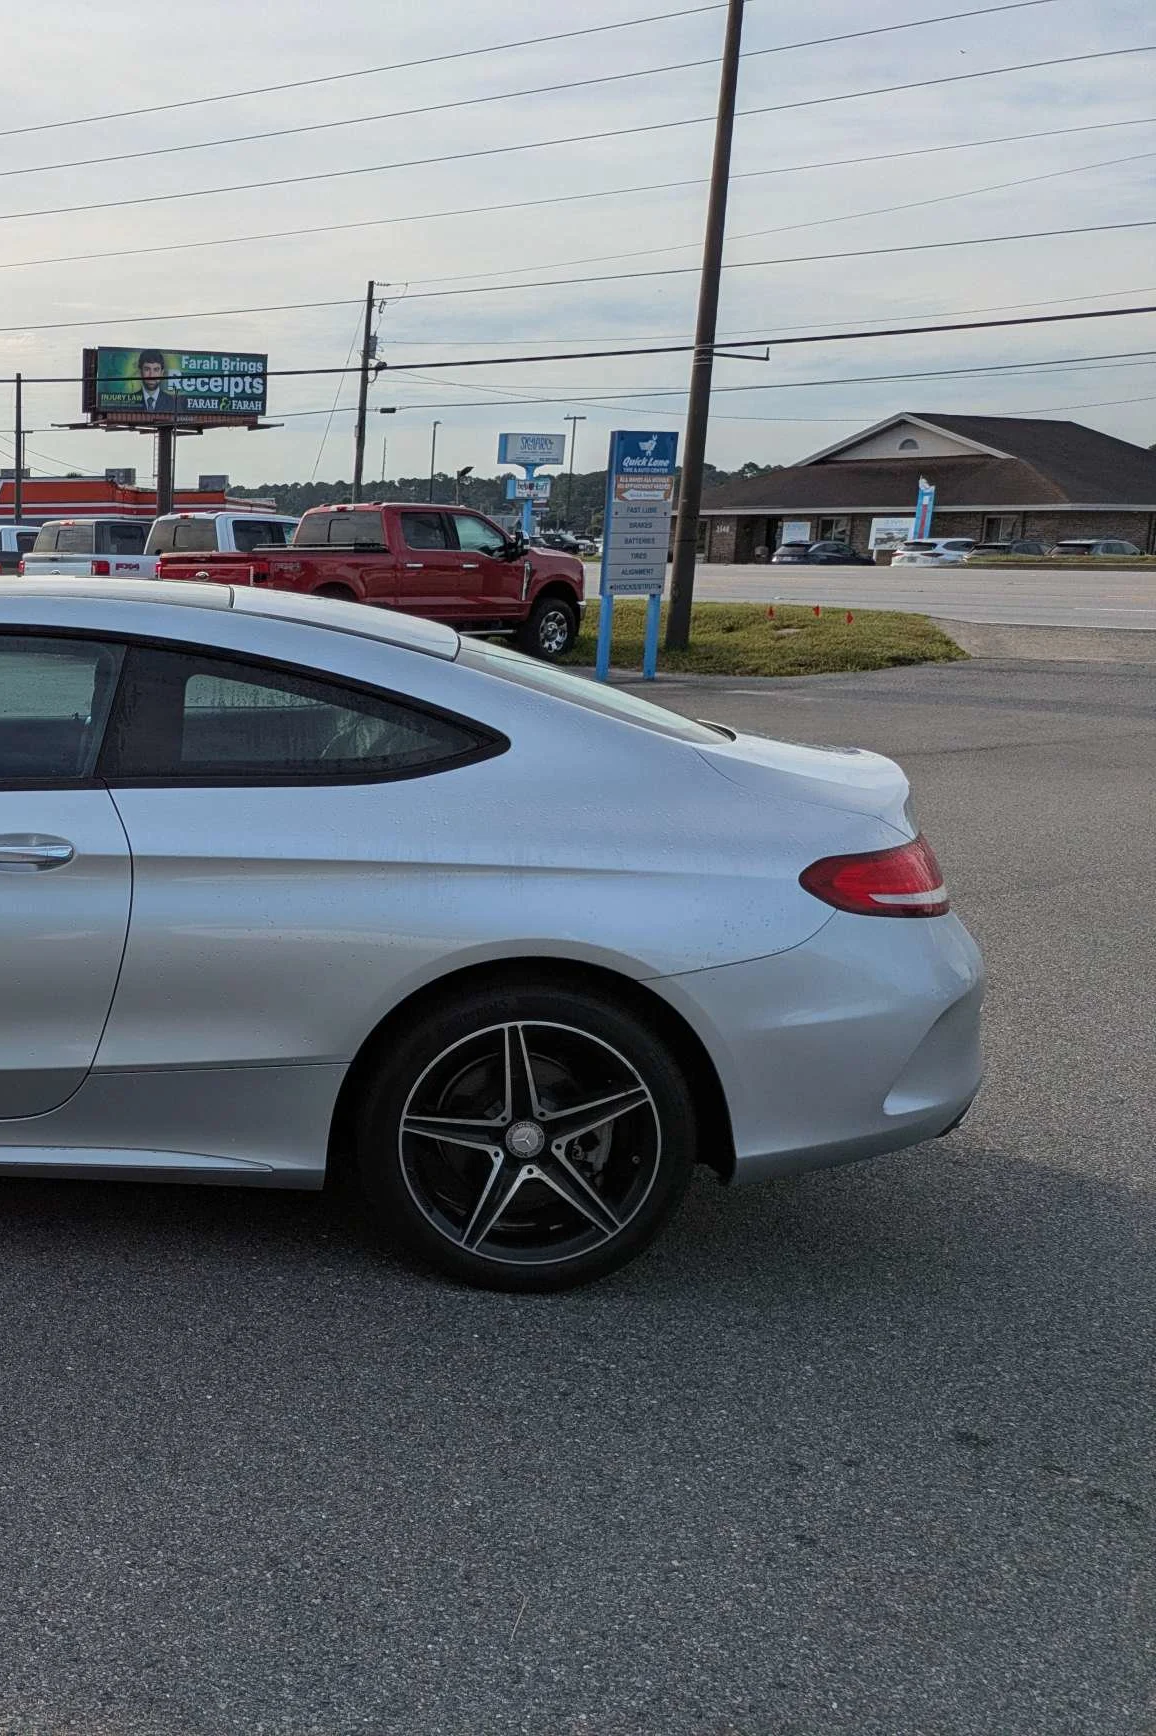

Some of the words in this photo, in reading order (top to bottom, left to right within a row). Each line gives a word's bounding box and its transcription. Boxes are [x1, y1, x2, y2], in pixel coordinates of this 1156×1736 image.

[181, 356, 218, 370] Farah
[221, 358, 263, 374] Brings
[167, 369, 264, 397] Receipts
[100, 393, 125, 401] INJURY
[187, 398, 219, 409] FARAH
[231, 400, 263, 411] FARAH
[622, 456, 648, 467] Quick
[648, 457, 670, 467] Lane
[621, 568, 654, 576] ALIGNMENT
